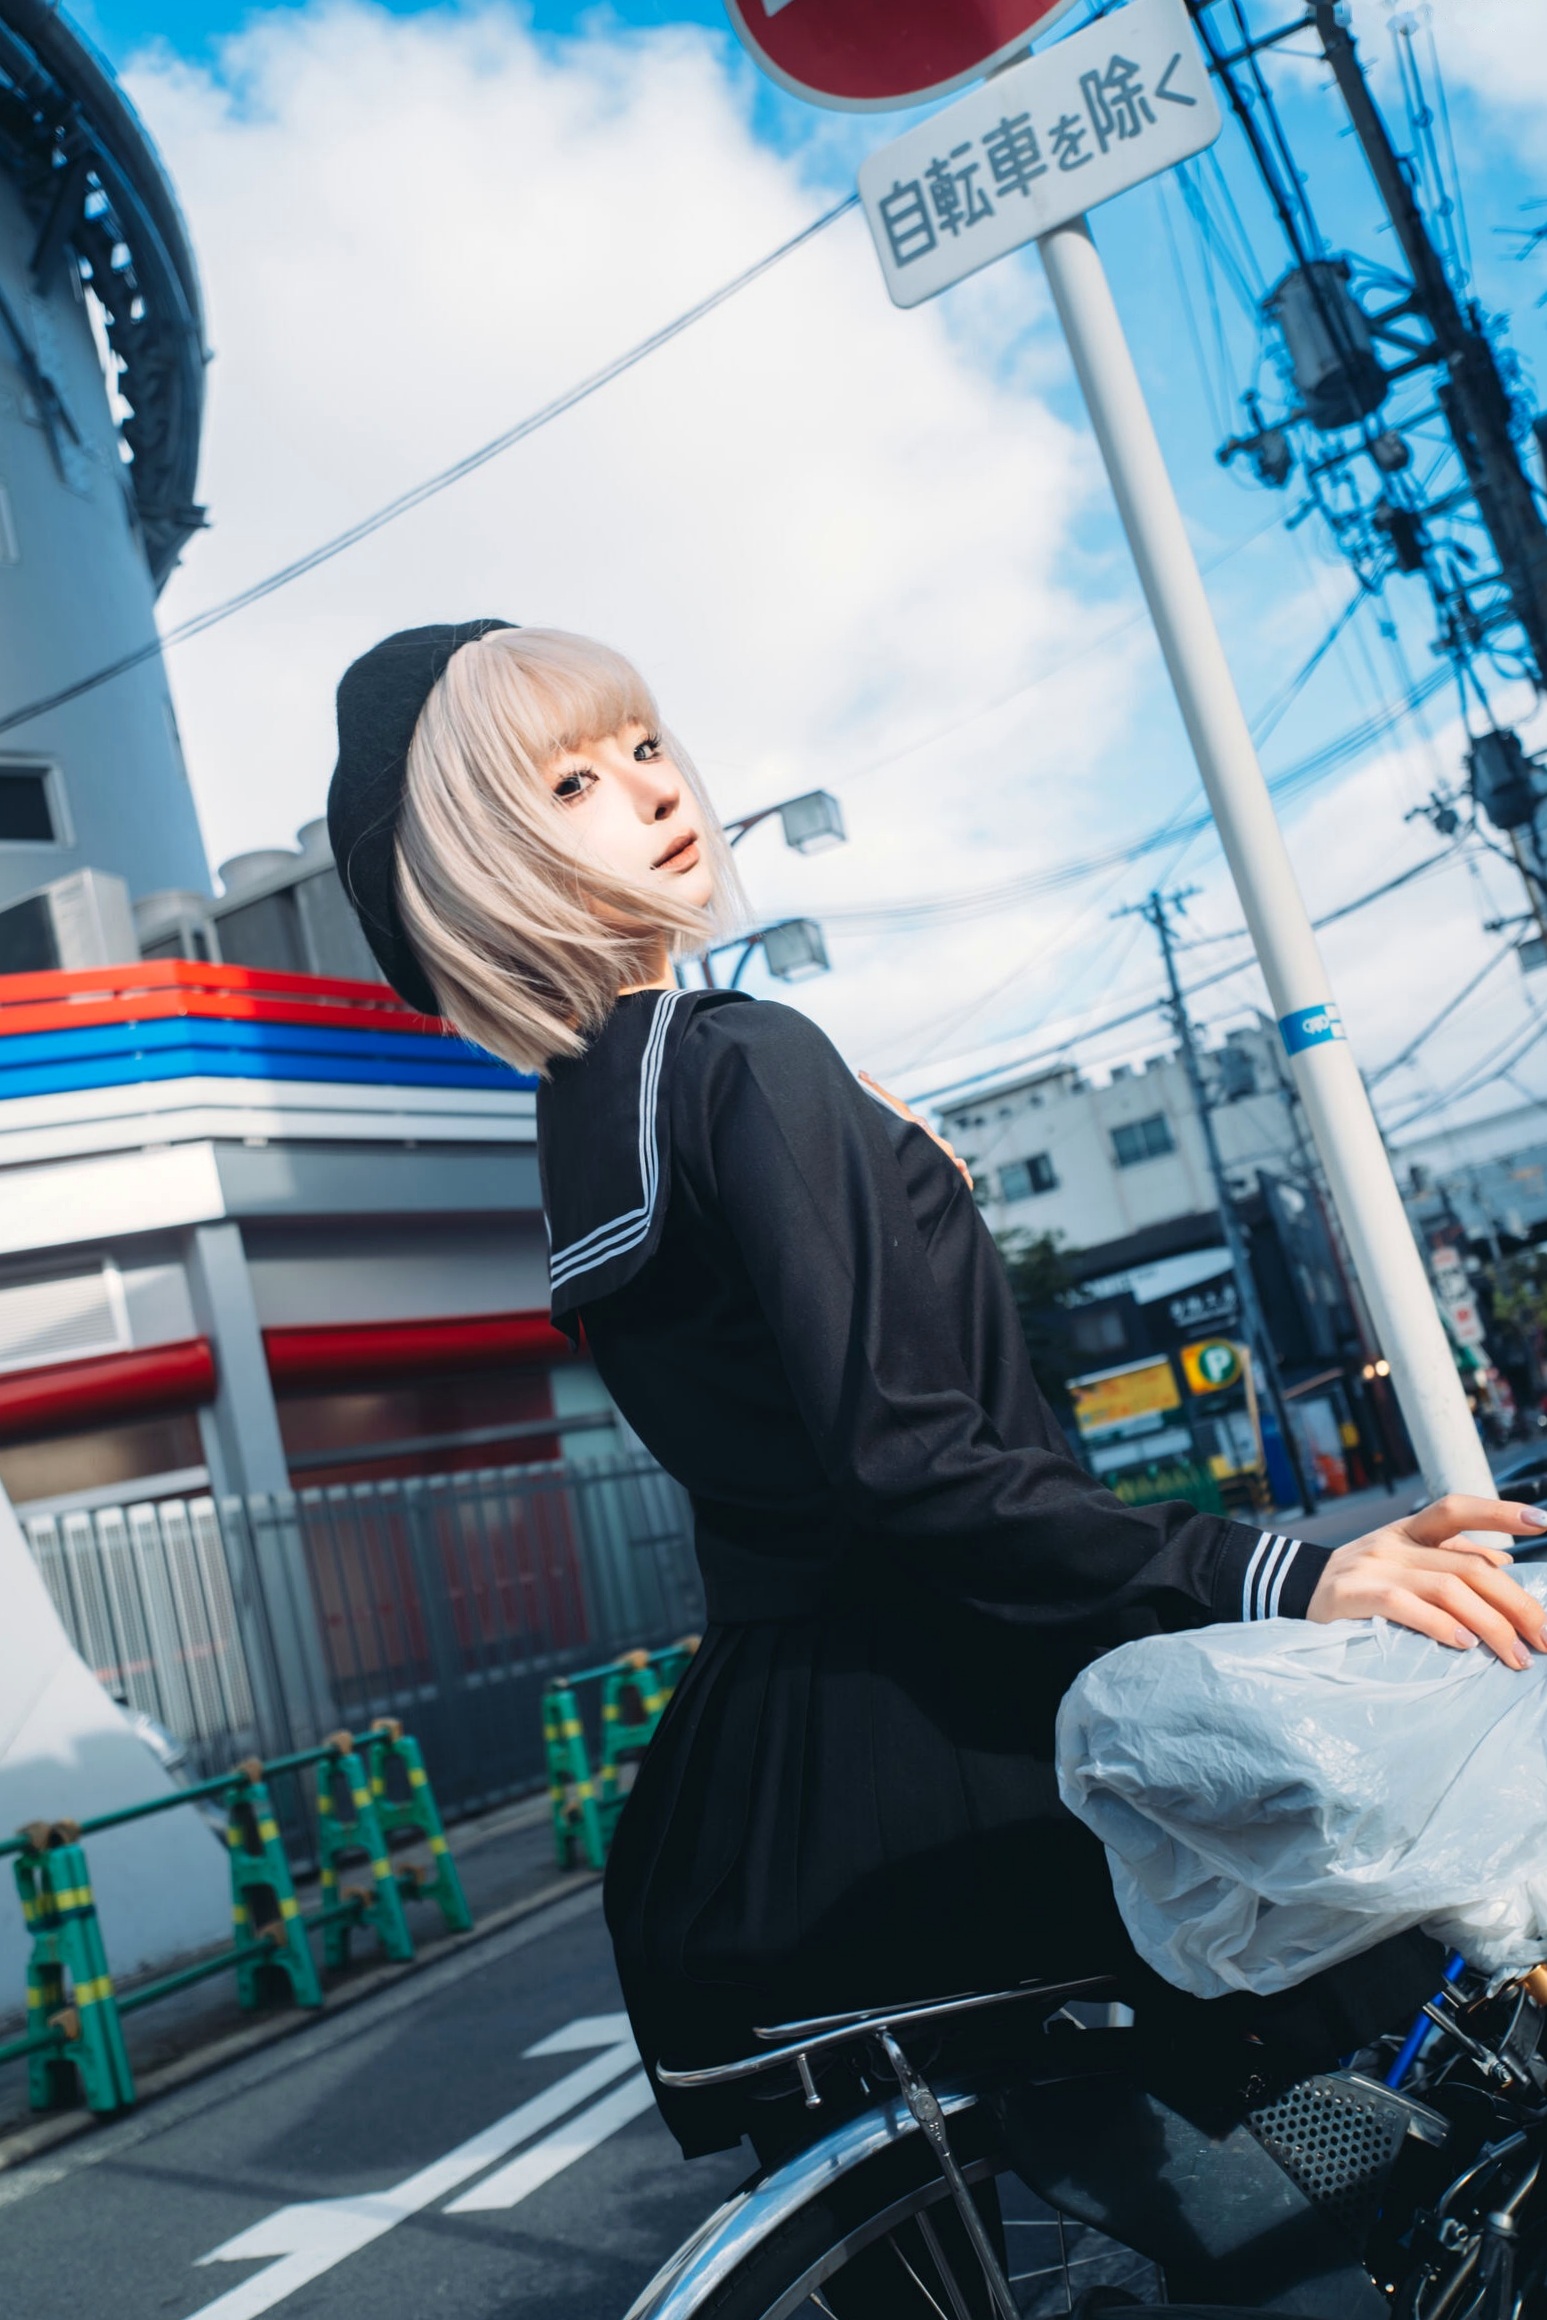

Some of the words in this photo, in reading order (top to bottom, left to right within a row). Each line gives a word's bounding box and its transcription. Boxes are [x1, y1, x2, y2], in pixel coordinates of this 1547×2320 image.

[878, 52, 1198, 270] 自転車を除く
[1205, 1347, 1232, 1383] P
